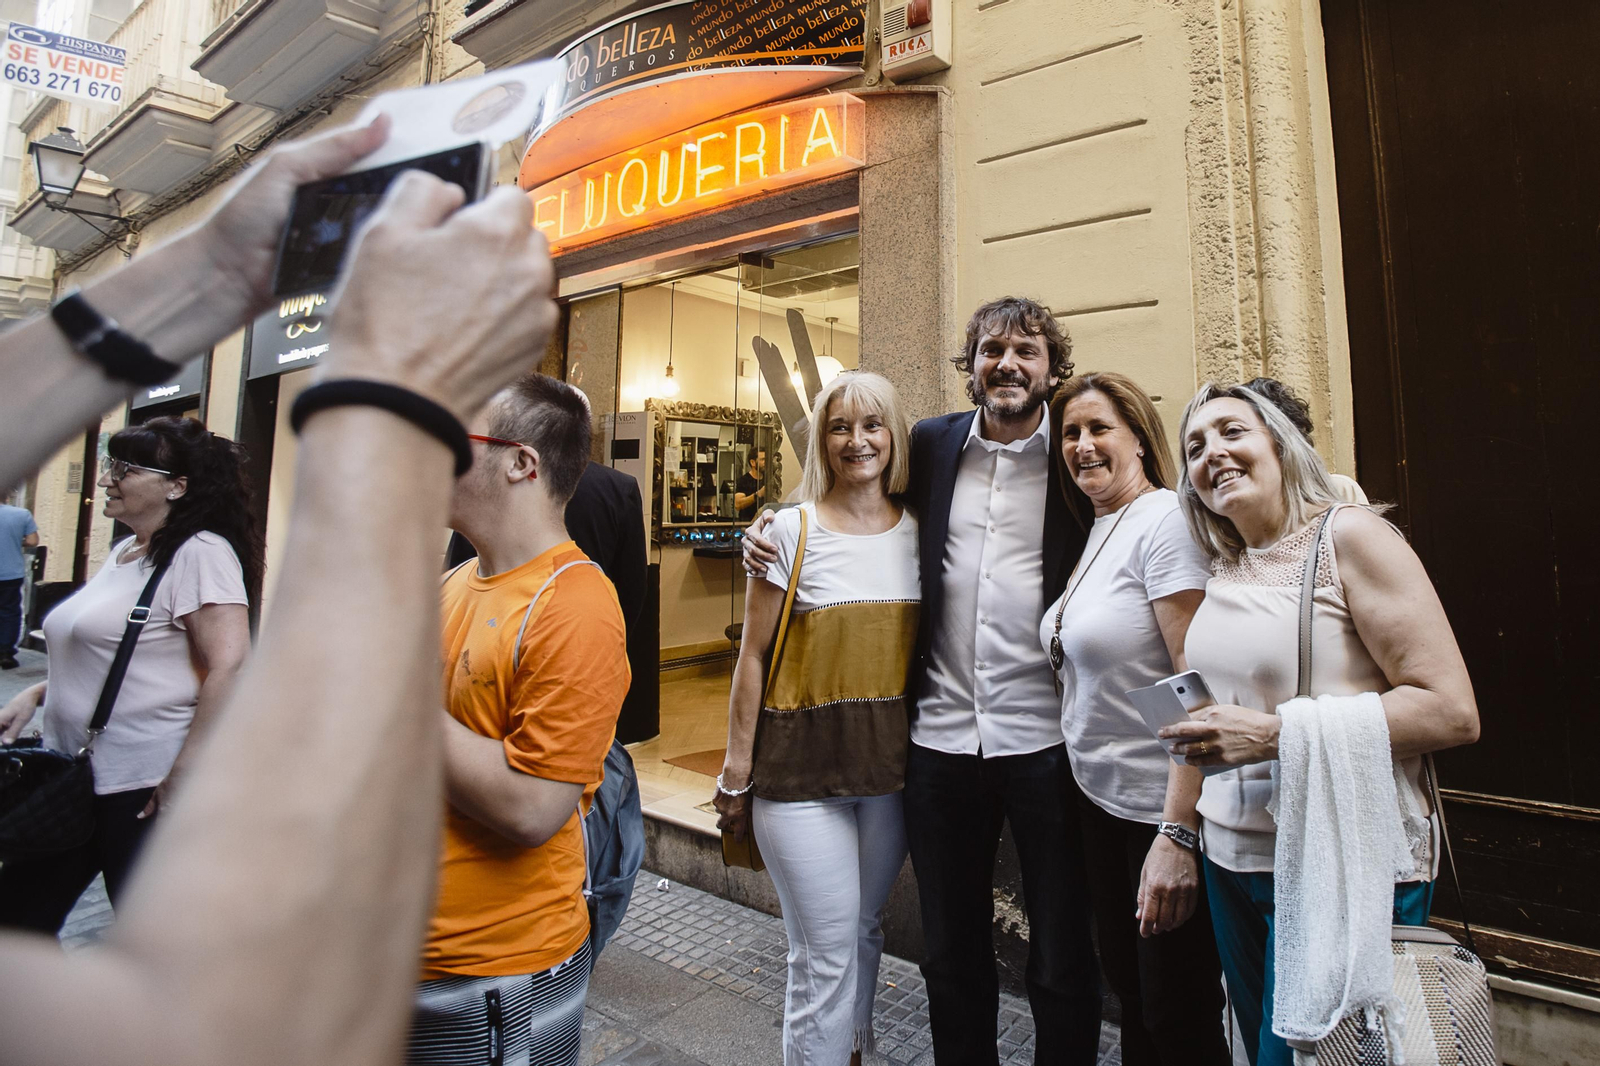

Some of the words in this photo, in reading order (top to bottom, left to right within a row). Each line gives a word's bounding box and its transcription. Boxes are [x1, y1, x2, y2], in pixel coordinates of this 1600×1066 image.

[59, 36, 126, 59] HISPANIA
[890, 36, 926, 57] RUCA
[8, 43, 39, 65] SE
[47, 51, 125, 83] VENDE
[4, 63, 40, 85] 663
[46, 72, 80, 94] 271
[88, 81, 121, 101] 670
